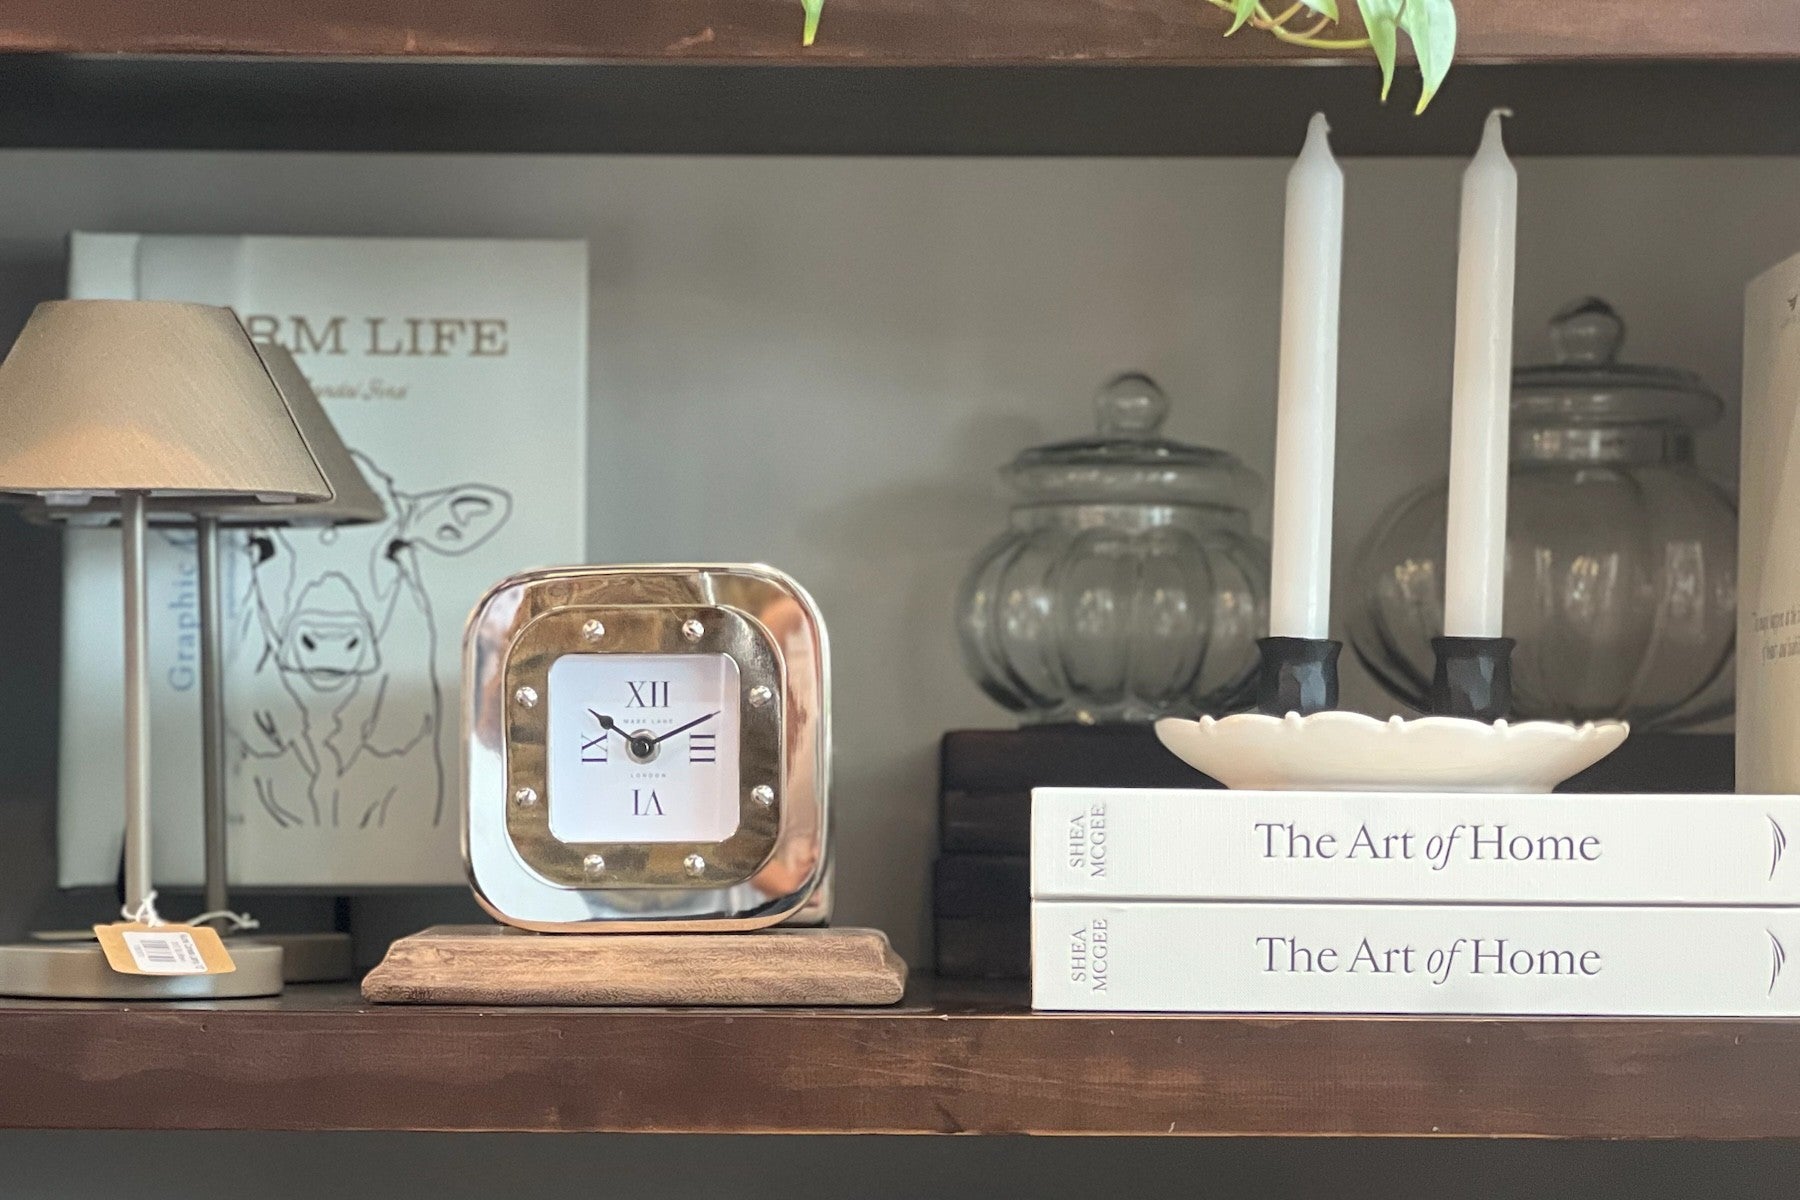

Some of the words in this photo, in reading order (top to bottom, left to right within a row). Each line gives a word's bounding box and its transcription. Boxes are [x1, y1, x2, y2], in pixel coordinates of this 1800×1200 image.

[246, 314, 347, 355] RM
[364, 317, 509, 357] LIFE
[168, 562, 202, 691] Graphic
[625, 680, 670, 708] XII
[1070, 813, 1085, 868] SHEA
[1090, 804, 1107, 877] MCGEE
[1255, 820, 1338, 859] The
[1346, 823, 1416, 860] Art
[1426, 824, 1466, 871] of
[1469, 824, 1603, 861] Home
[1071, 927, 1087, 982] SHEA
[1092, 918, 1108, 991] MCGEE
[1256, 935, 1338, 973] The
[1347, 937, 1416, 974] Art
[1427, 938, 1467, 985] of
[1471, 938, 1603, 976] Home
